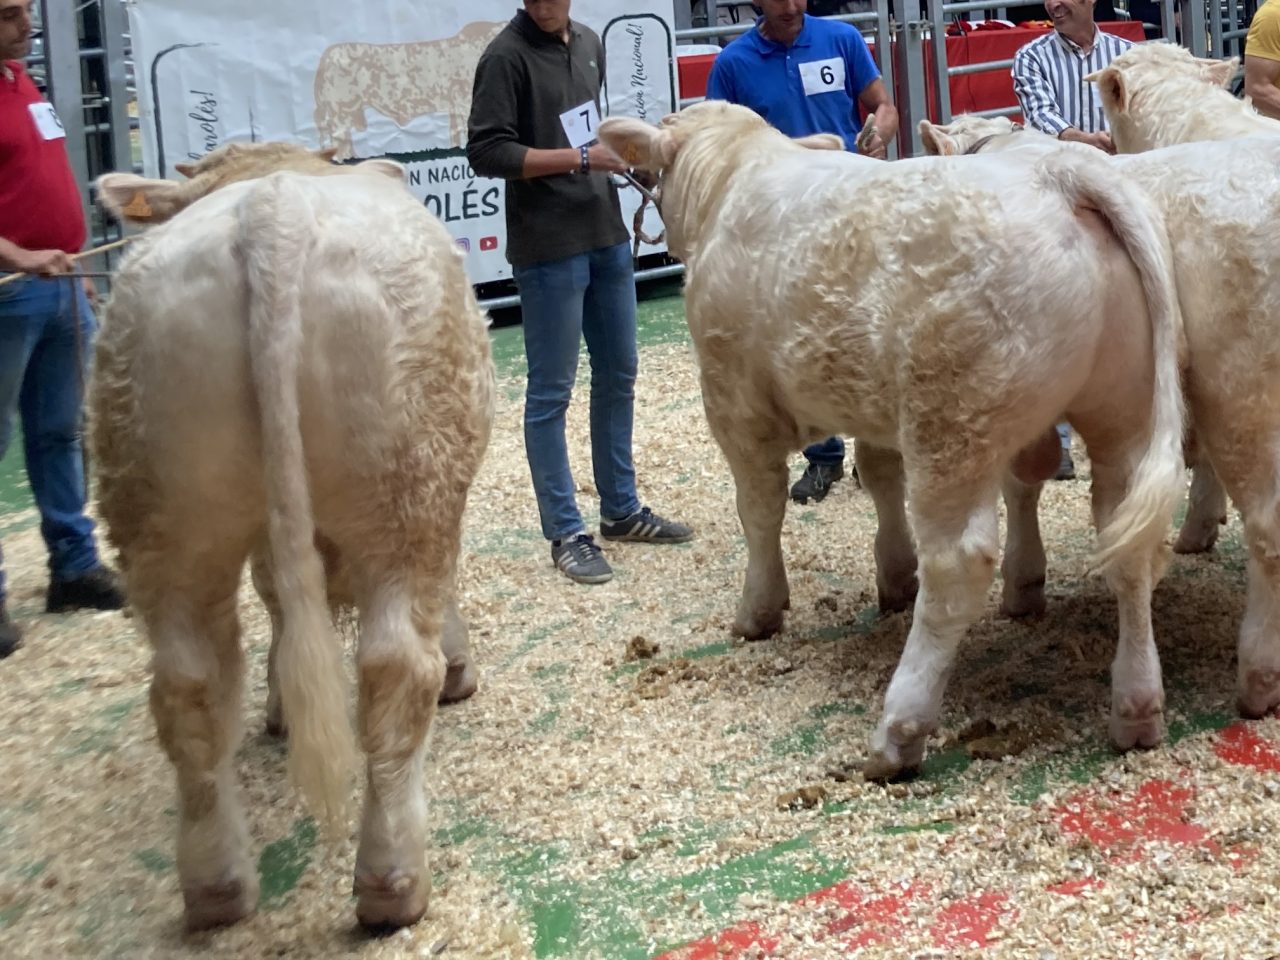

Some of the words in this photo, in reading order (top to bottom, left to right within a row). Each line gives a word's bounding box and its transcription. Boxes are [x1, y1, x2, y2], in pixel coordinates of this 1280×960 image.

[625, 23, 648, 87] Nacional!
[820, 65, 835, 86] 6
[186, 90, 219, 160] arolés!
[579, 109, 592, 133] 7
[427, 163, 476, 184] NACIO
[423, 180, 500, 222] OLÉS
